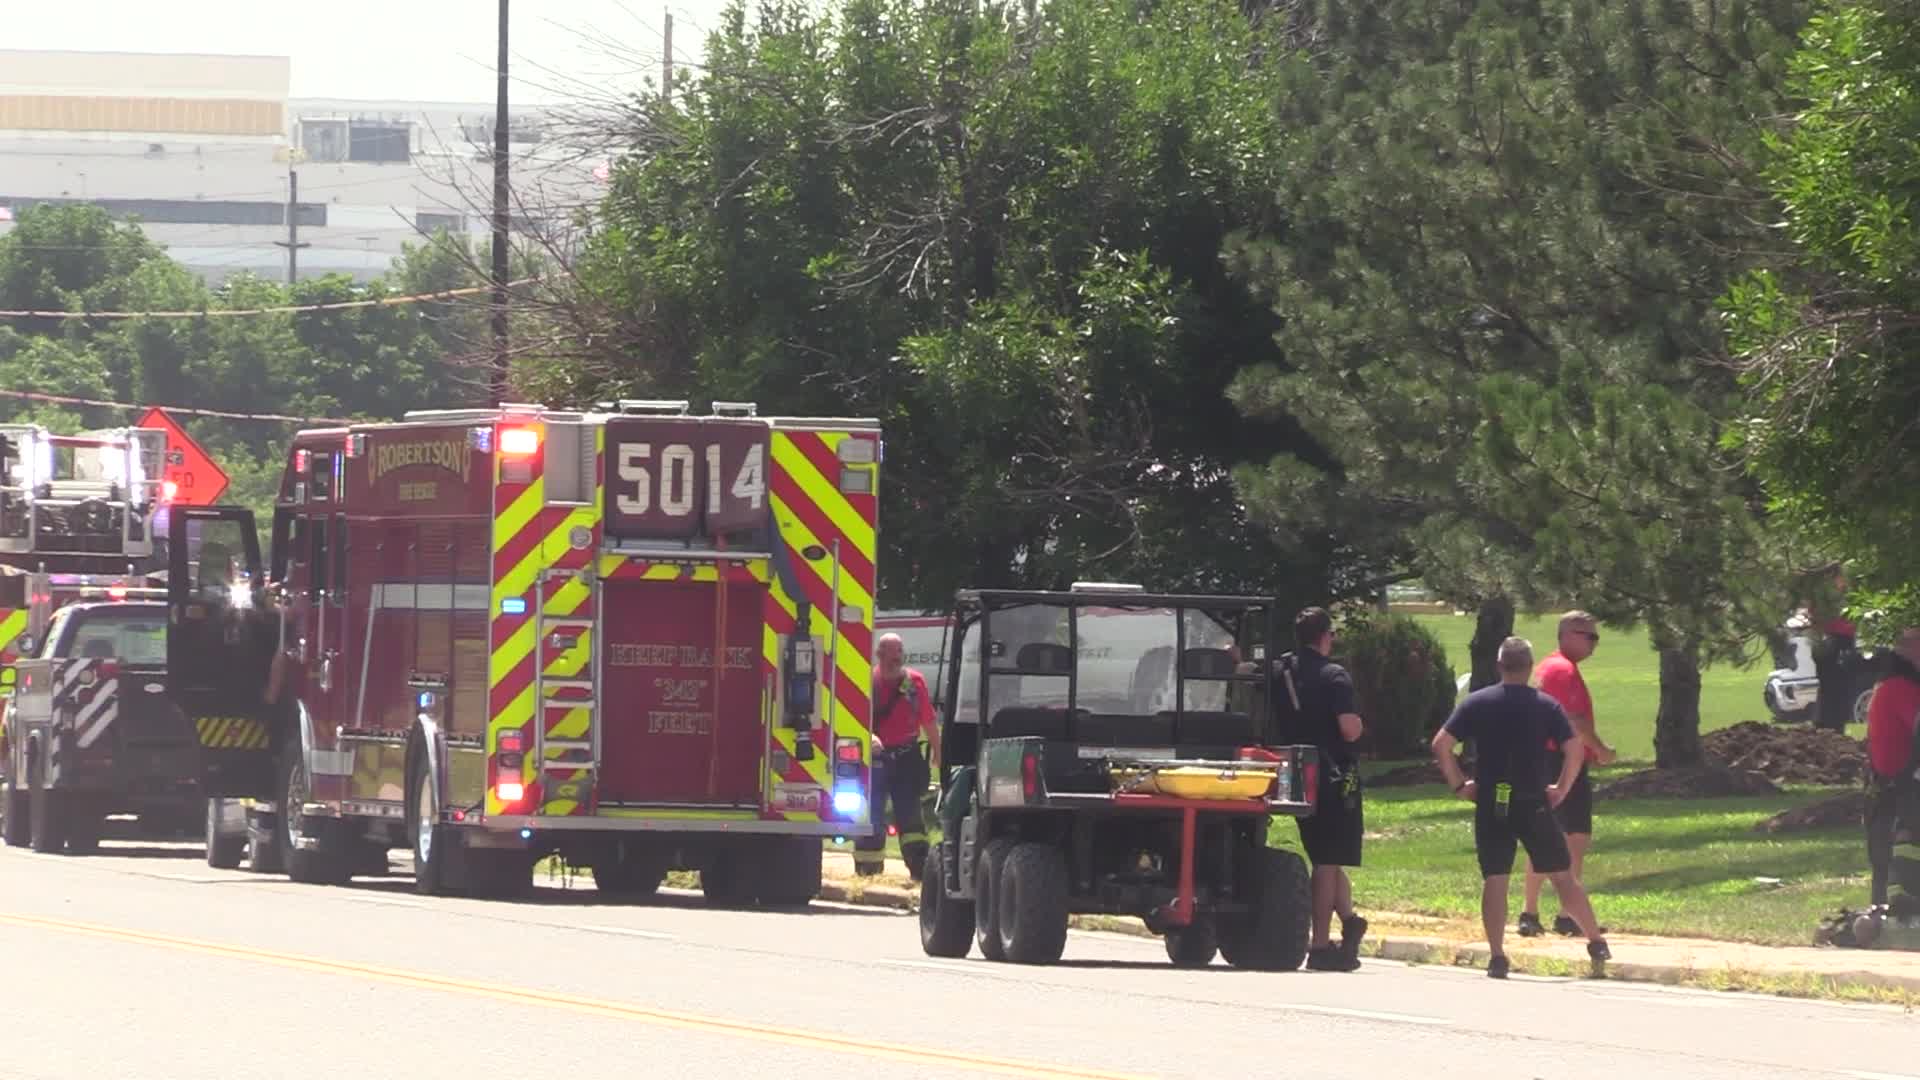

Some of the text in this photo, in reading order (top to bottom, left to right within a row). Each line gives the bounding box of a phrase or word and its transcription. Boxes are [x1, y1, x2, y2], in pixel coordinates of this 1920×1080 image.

[377, 440, 462, 476] ROBERTSON
[616, 442, 766, 517] 5014
[608, 643, 679, 667] KEEP
[647, 710, 713, 735] FEET
